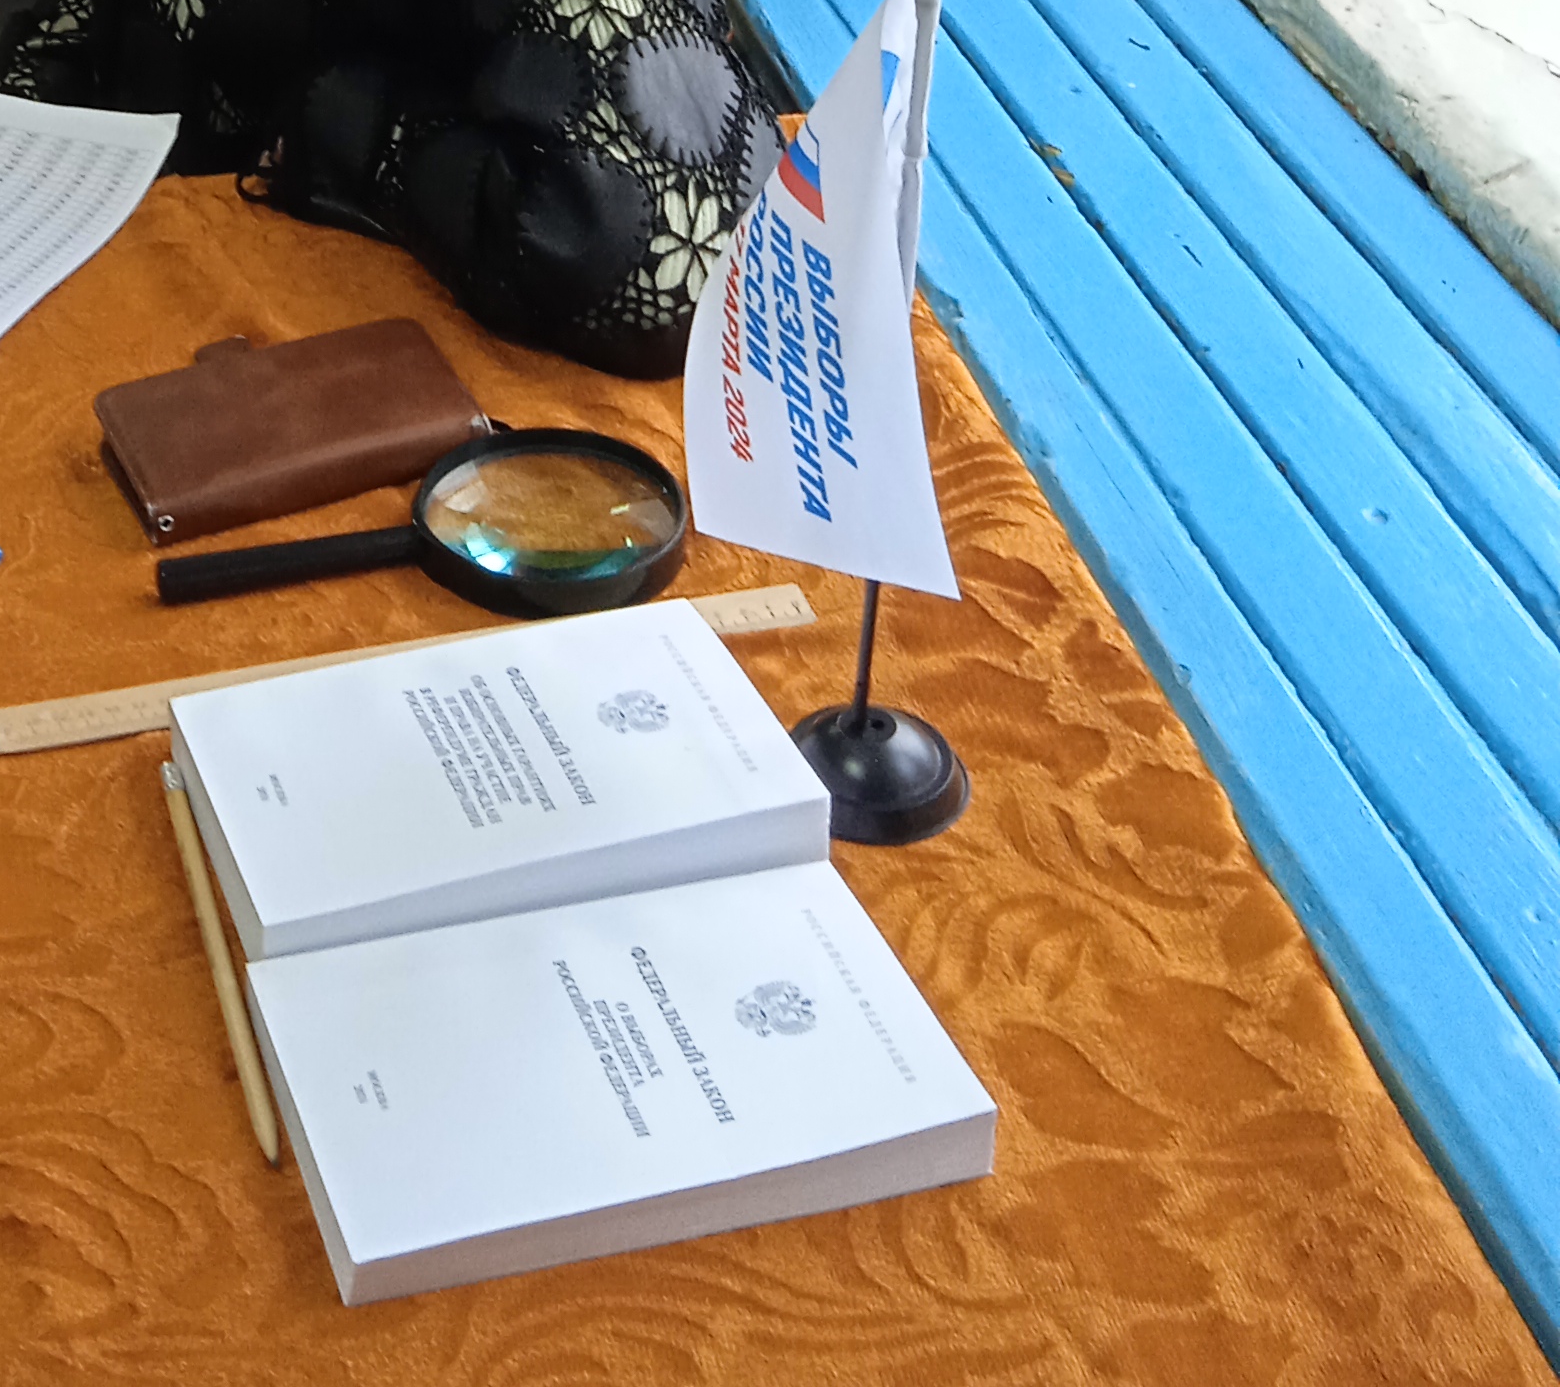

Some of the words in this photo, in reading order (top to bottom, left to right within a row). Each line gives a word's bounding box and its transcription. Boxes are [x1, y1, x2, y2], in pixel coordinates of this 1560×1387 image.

[722, 254, 742, 376] МАРТА
[744, 186, 774, 384] РОССИИ
[801, 238, 858, 470] ВЫБОРЫ
[722, 373, 754, 463] 2024
[770, 209, 832, 523] ПРЕЗИДЕНТА
[505, 665, 570, 757] ФЕДЕРАЛЬНЫЙ
[557, 756, 597, 806] ЗАКОН
[551, 959, 609, 1051] РОССИЙСКОЙ
[598, 1051, 651, 1138] ФЕДЕРАЦИИ
[592, 999, 646, 1087] ПРЕЗИДЕНТА
[620, 1013, 663, 1078] ВЫБОРАХ
[630, 945, 706, 1064] ФЕДЕРАЛЬНЫЙ
[692, 1065, 735, 1123] ЗАКОН
